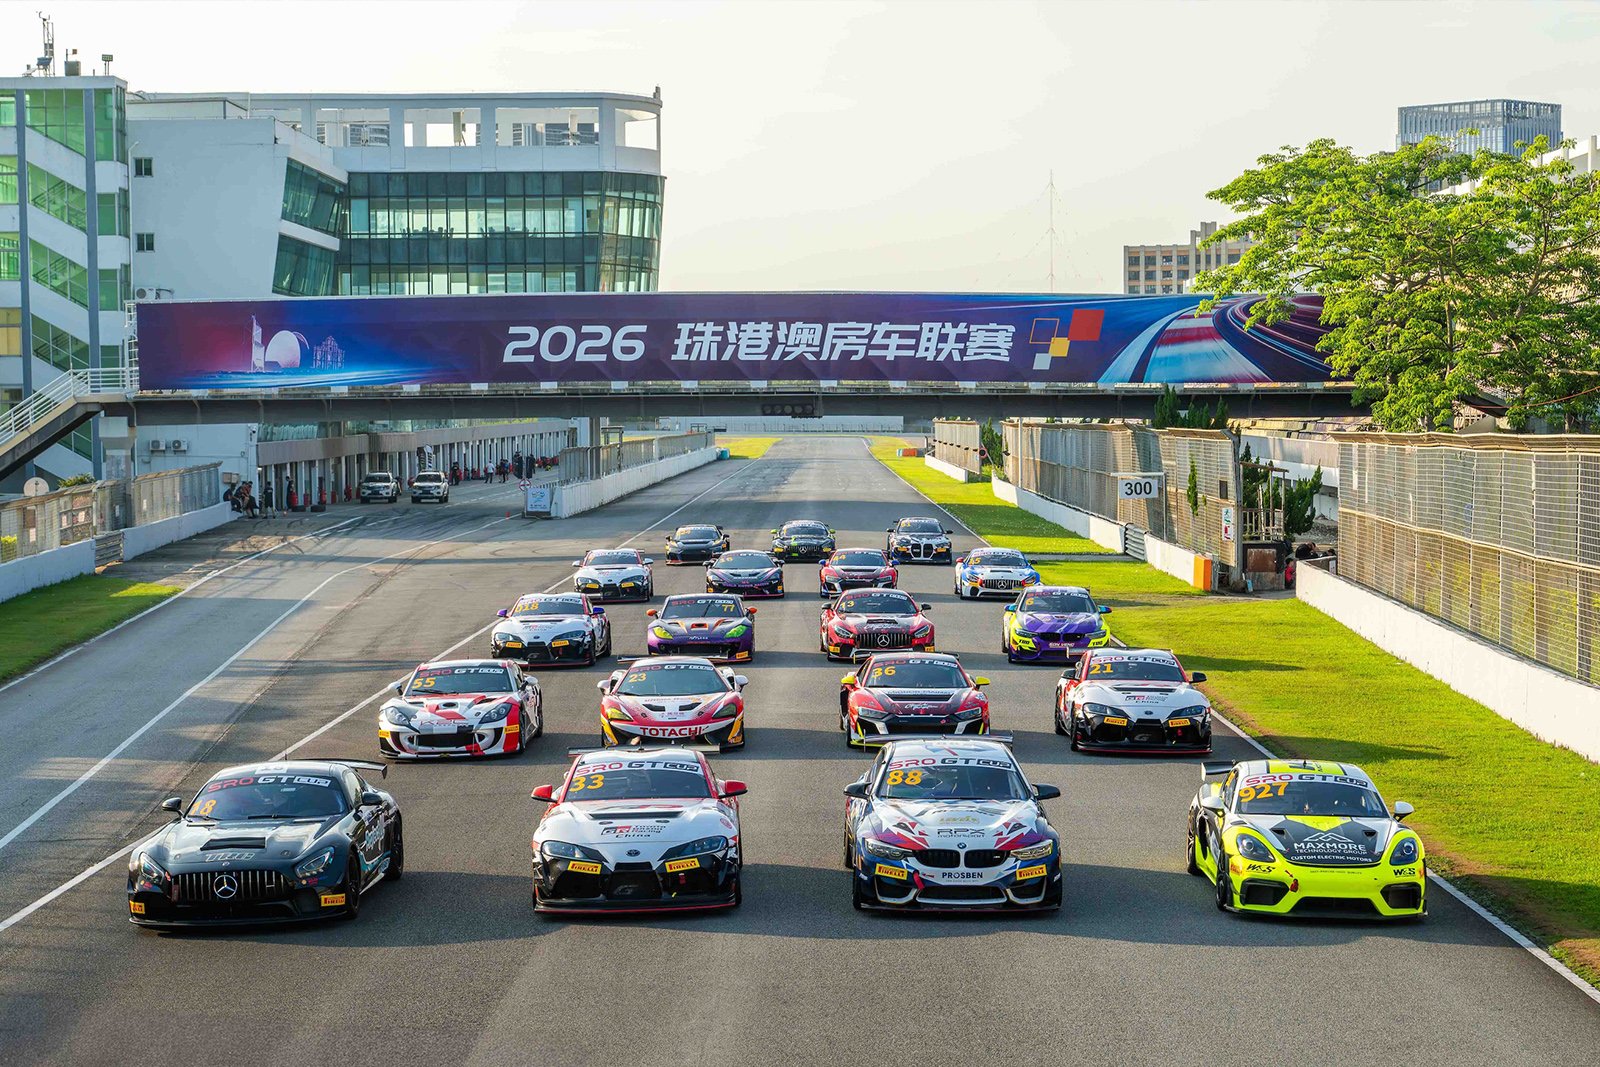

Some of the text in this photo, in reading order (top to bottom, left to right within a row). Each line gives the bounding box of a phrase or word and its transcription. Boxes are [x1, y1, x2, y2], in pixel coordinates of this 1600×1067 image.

[502, 321, 1017, 363] 2026 珠港澳房车联赛
[1124, 481, 1152, 496] 300
[840, 600, 855, 610] 13
[1025, 597, 1034, 606] 6
[721, 604, 735, 612] 77
[1092, 656, 1124, 664] SRO
[420, 669, 452, 678] SRO
[871, 665, 896, 678] 36
[1089, 663, 1113, 674] 21
[411, 677, 436, 689] 55
[628, 671, 647, 683] 23
[640, 726, 702, 737] TOTACHI
[577, 762, 623, 776] SRO
[627, 760, 663, 769] GT
[889, 757, 1012, 771] SRO GT CUP
[569, 773, 605, 792] 33
[886, 769, 923, 786] 88
[1246, 774, 1368, 788] SRO GT CUP
[207, 777, 254, 793] SRO
[257, 775, 294, 784] GT
[1238, 781, 1289, 803] 927
[190, 799, 217, 815] 18
[1293, 842, 1366, 851] MAXMORE
[570, 863, 599, 873] PIRELLI
[668, 860, 697, 871] PIRELLI
[877, 866, 906, 878] PIRELLI
[942, 871, 983, 879] PROSBEN
[1018, 867, 1045, 878] PIRELLI
[323, 895, 345, 905] PIRELLI
